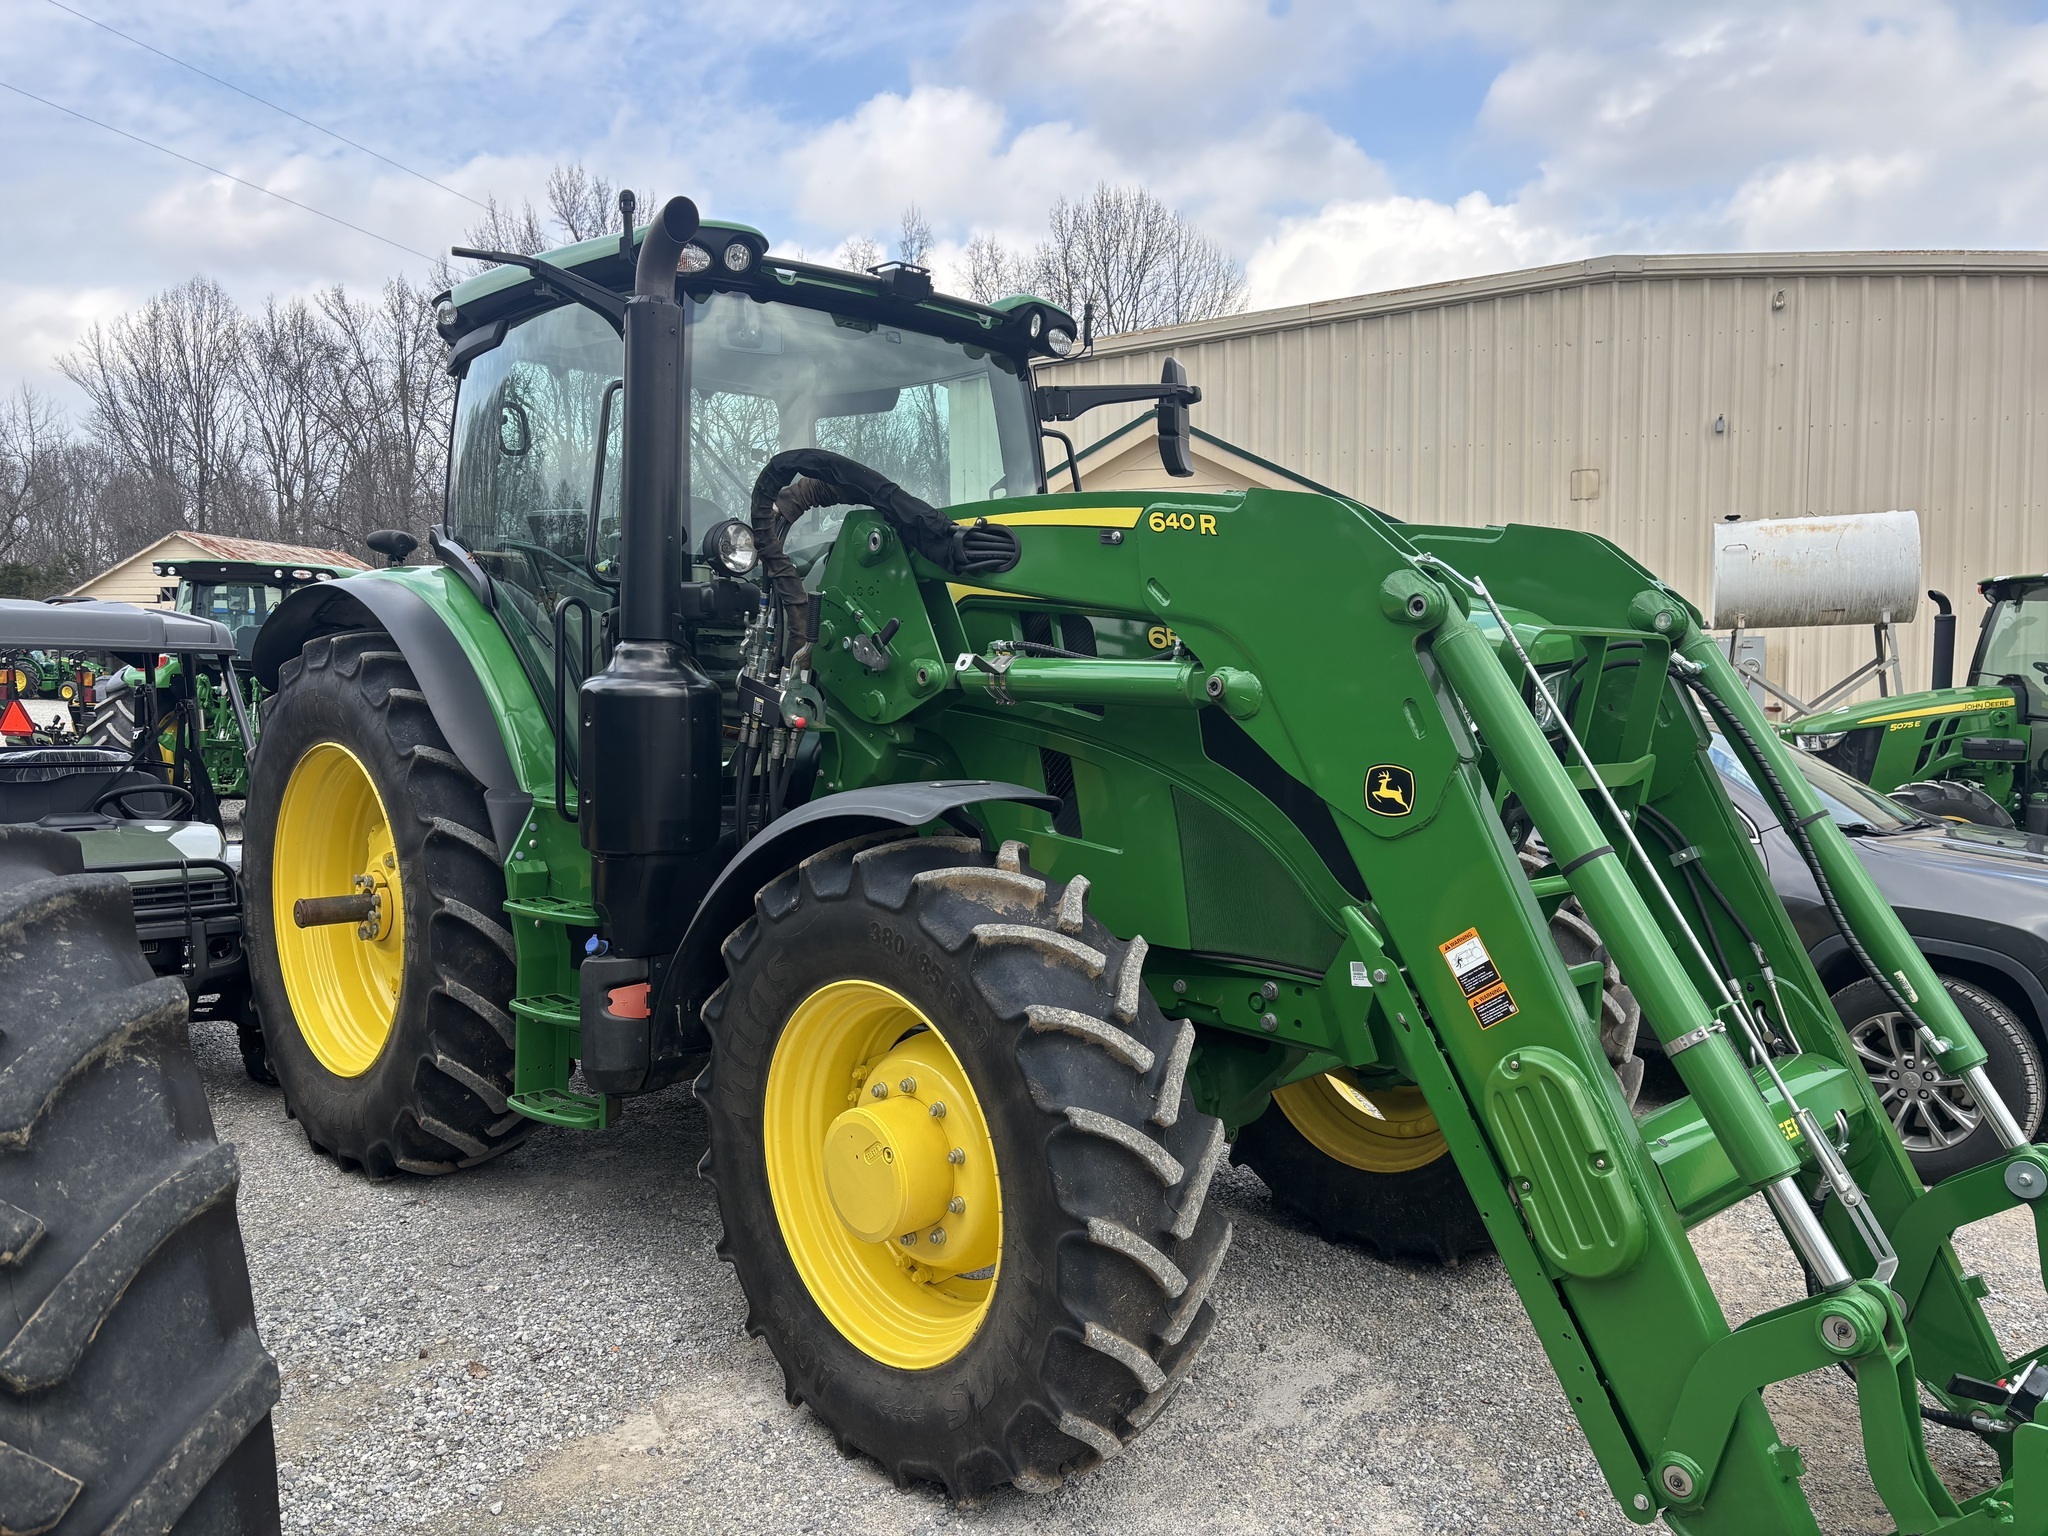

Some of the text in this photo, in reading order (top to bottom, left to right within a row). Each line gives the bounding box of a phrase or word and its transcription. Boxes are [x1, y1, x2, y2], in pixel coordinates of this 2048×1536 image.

[1148, 511, 1218, 535] 640 R
[1889, 721, 1914, 732] 5075
[1449, 931, 1474, 948] WARNING
[1478, 986, 1504, 1002] WARNING
